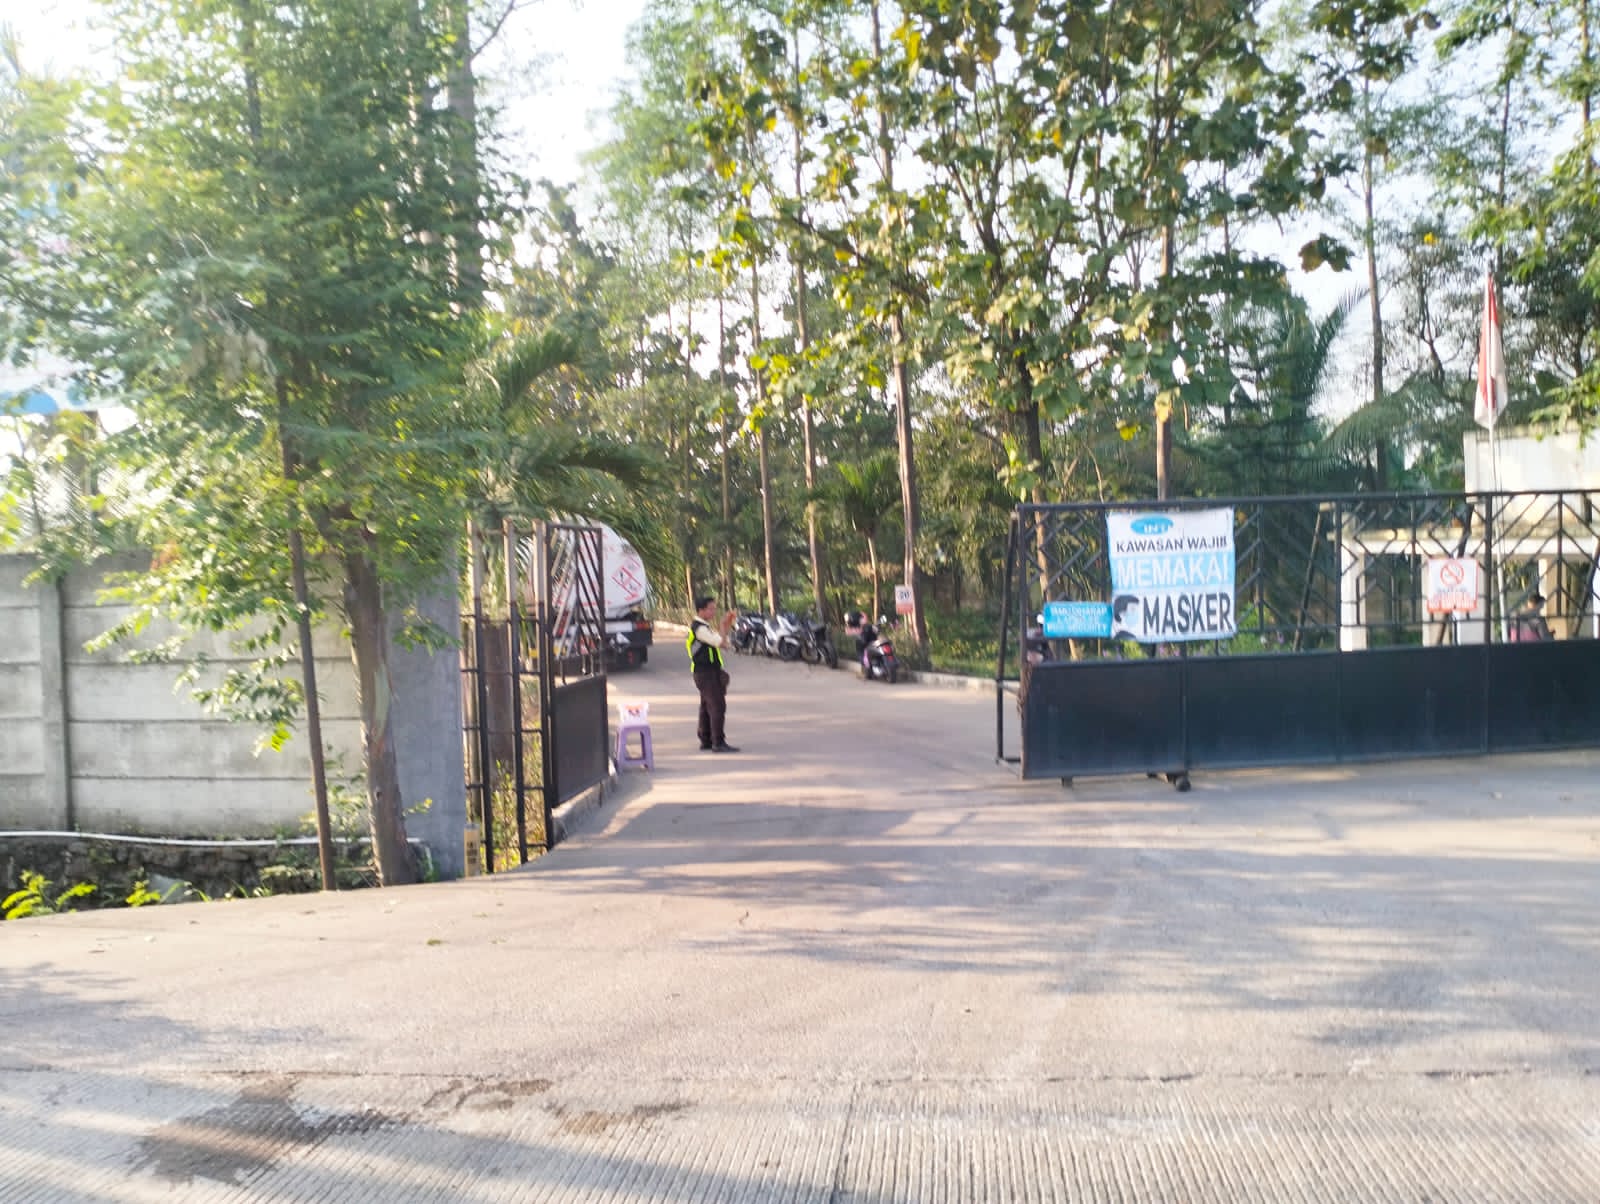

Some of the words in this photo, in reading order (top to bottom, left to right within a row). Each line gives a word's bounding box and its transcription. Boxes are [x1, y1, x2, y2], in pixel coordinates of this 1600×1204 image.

[1116, 538, 1184, 553] KAWASAN
[1186, 535, 1228, 550] WAJIB
[1117, 555, 1229, 588] MEMAKAI
[1142, 592, 1233, 635] MASKER
